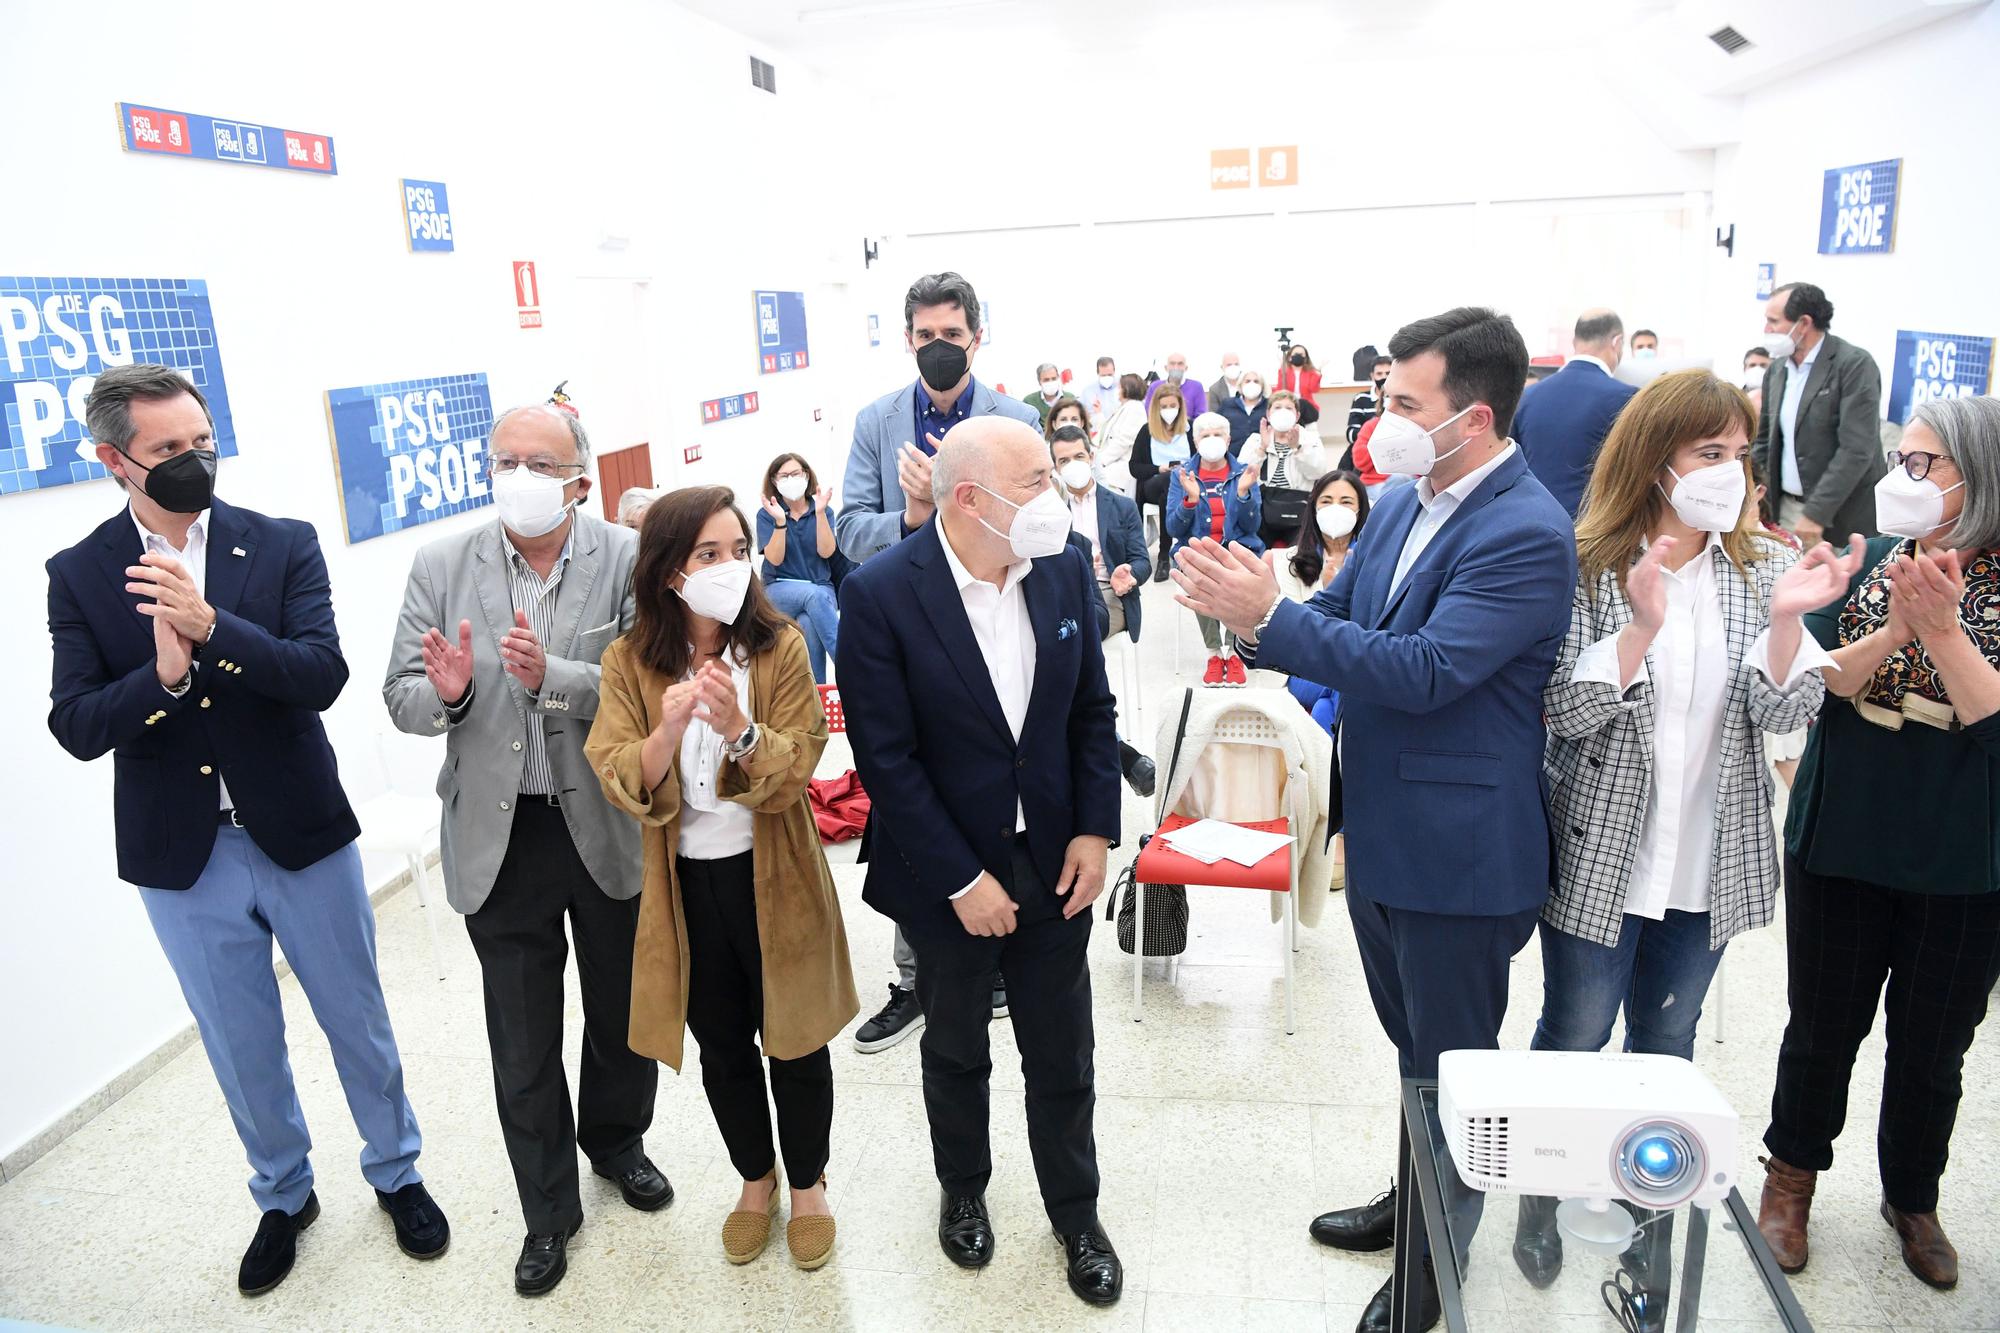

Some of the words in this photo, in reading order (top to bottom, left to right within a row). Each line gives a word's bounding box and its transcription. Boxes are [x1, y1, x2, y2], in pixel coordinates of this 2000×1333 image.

[132, 115, 151, 129] PSG
[134, 127, 161, 144] PSOE
[215, 128, 231, 141] PSG
[217, 139, 239, 153] PSOE
[405, 186, 436, 212] PSG
[1839, 169, 1873, 207] PSG
[409, 211, 452, 240] PSOE
[1834, 204, 1886, 248] PSOE
[62, 294, 84, 313] DE
[1, 294, 134, 373] PSG
[1915, 339, 1957, 380] PSG
[380, 389, 450, 451] PSG
[390, 440, 488, 519] PSOE
